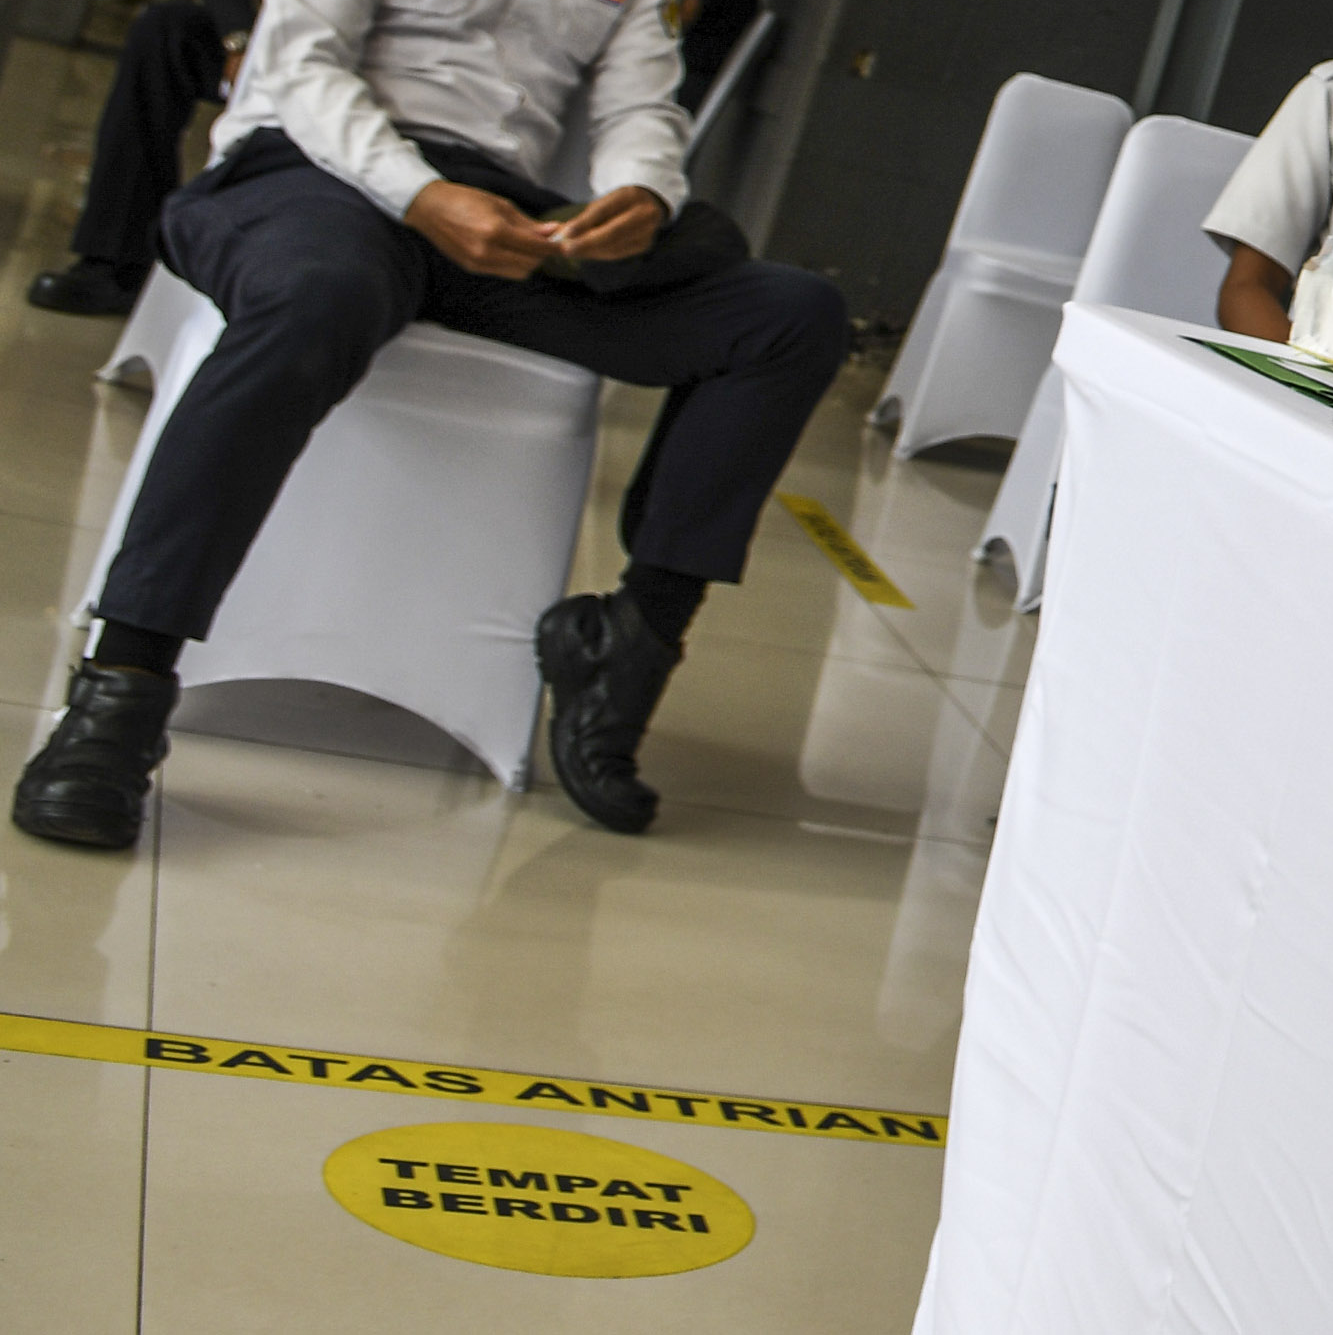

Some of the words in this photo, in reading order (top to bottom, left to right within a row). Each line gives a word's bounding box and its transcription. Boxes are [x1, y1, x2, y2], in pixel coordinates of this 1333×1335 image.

[144, 1038, 486, 1096] BATAS
[515, 1081, 941, 1141] ANTRIAN
[378, 1157, 693, 1203] TEMPAT
[381, 1187, 711, 1234] BERDIRI
